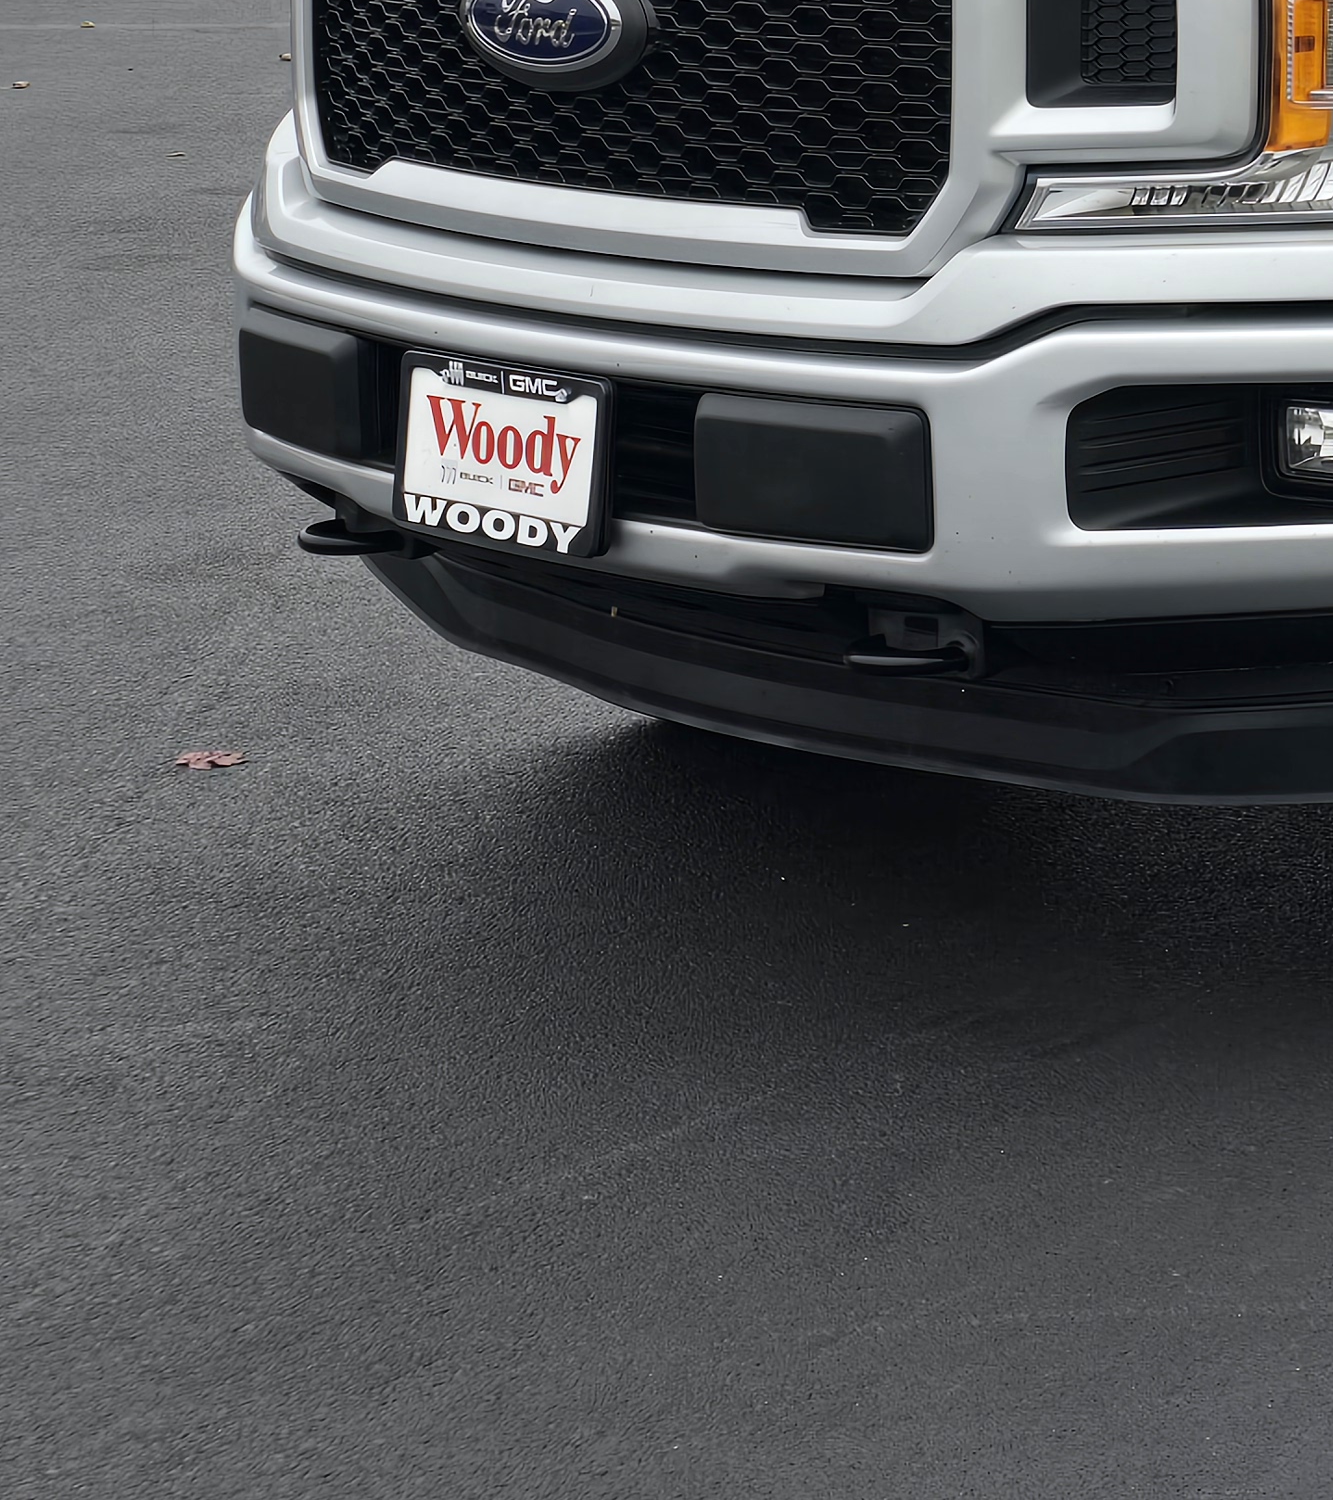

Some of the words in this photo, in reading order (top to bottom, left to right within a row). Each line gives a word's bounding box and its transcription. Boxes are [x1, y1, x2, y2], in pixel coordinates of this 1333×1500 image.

[465, 370, 499, 384] BUICK
[508, 374, 561, 397] GMC
[426, 395, 581, 494] Woody
[459, 471, 493, 485] BUICK
[508, 478, 544, 497] GMC
[404, 493, 582, 554] WOODY
